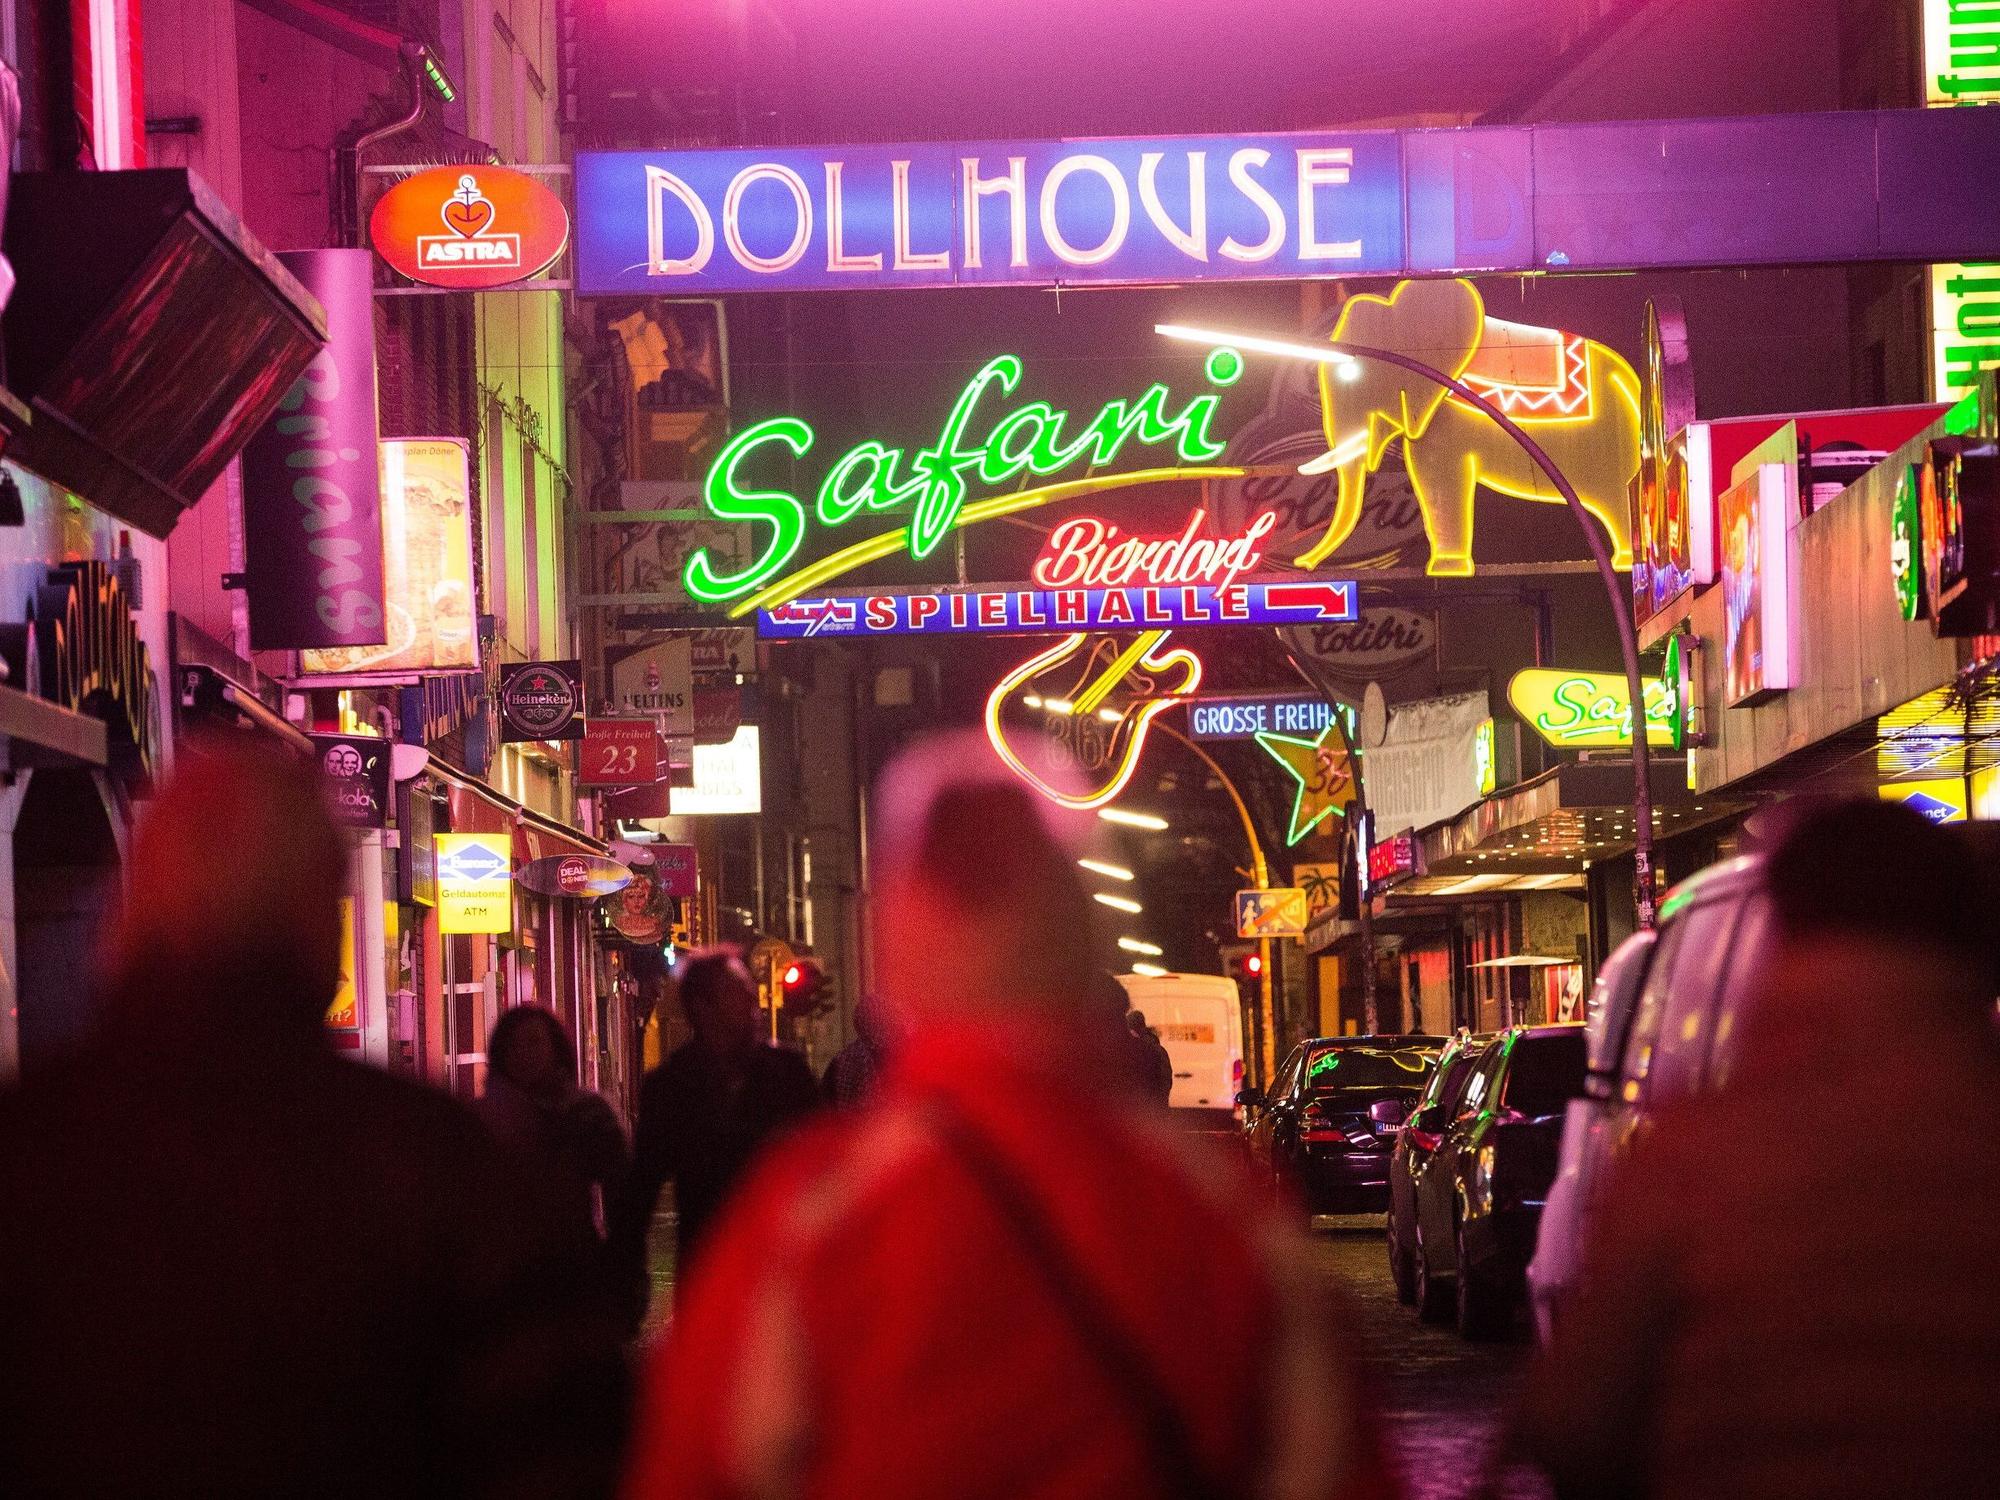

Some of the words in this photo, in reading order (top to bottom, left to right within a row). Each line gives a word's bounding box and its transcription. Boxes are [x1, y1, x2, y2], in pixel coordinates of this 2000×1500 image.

[645, 147, 1363, 277] DOLLHOUSE
[426, 241, 513, 262] ASTRA
[684, 347, 1244, 602] Safari
[1035, 510, 1276, 597] Bierdorf
[864, 584, 1250, 630] SPIELHALLE
[512, 693, 567, 705] Heineken
[1194, 705, 1267, 734] GROSSE
[615, 729, 651, 739] Freiheit
[599, 745, 638, 775] 23
[560, 866, 586, 877] DEAL
[442, 889, 505, 899] Geldautomat
[463, 907, 487, 916] ATM
